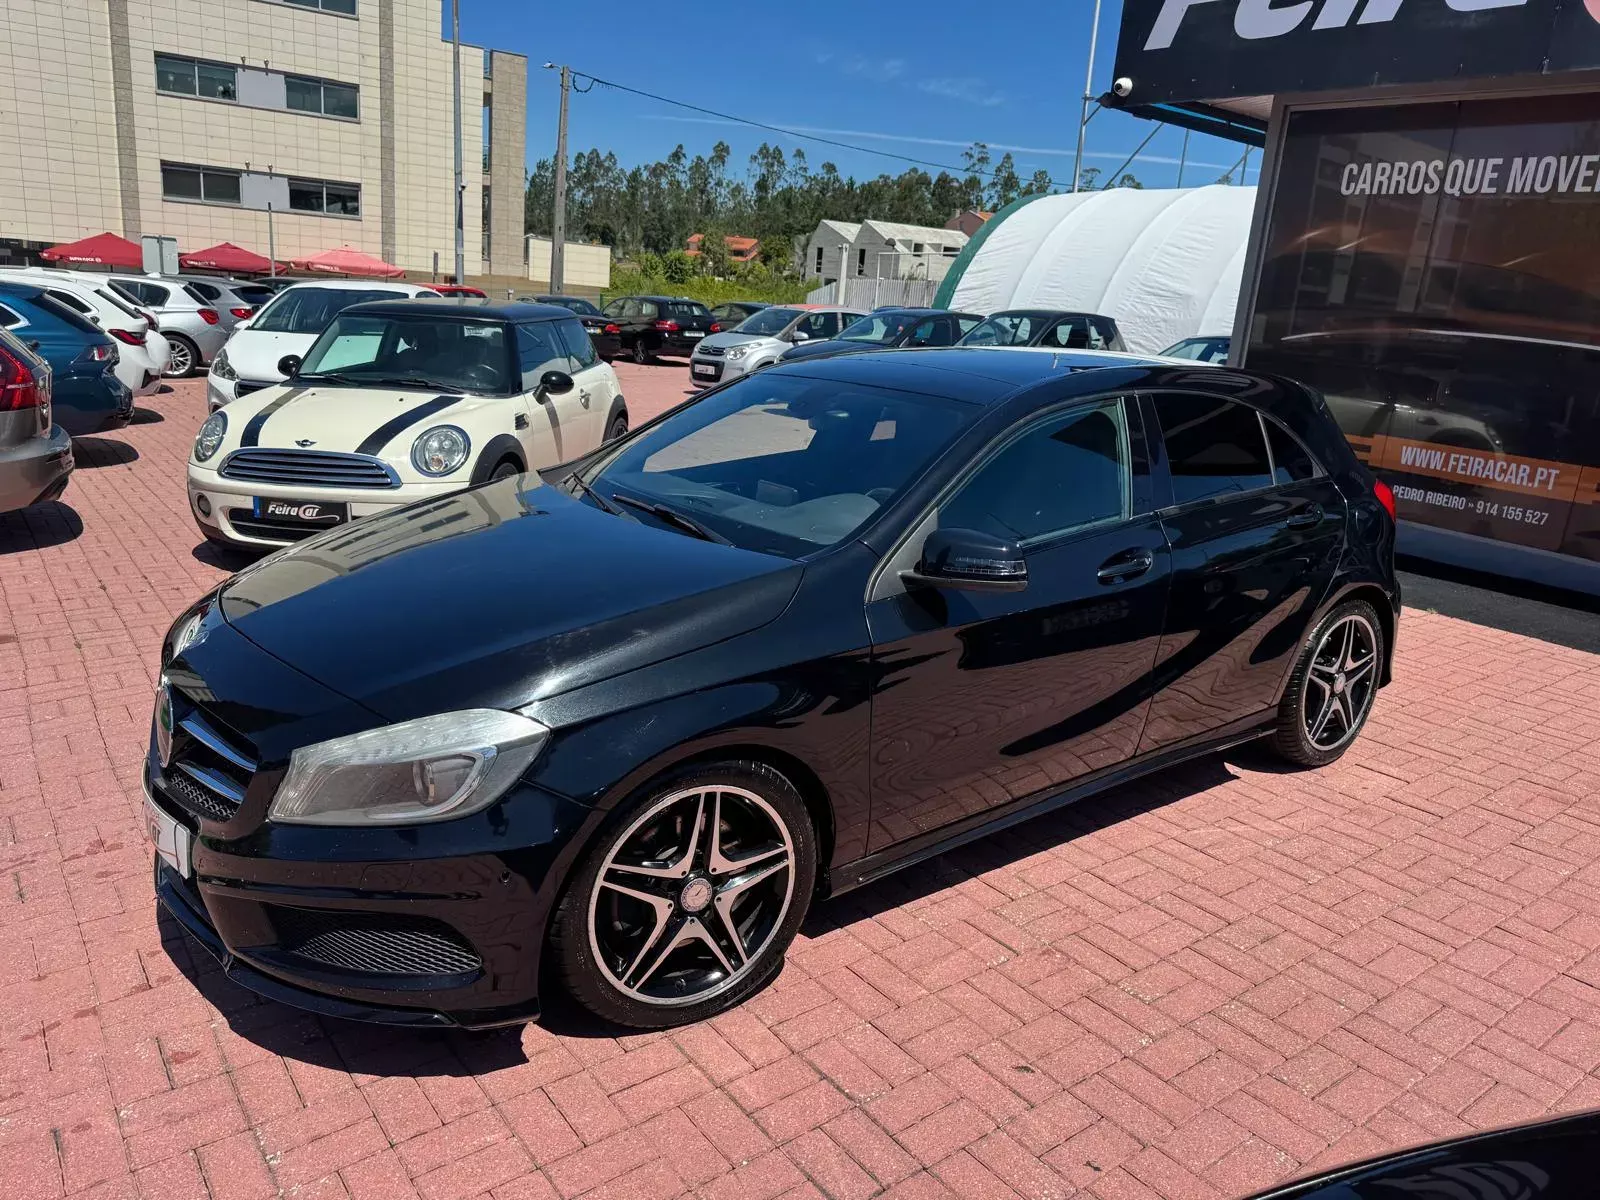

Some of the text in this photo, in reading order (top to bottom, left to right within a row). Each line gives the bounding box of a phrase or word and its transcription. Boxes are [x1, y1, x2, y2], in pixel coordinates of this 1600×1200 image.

[1340, 154, 1600, 197] CARROS QUE MOVE
[1400, 446, 1560, 490] WWW.FEIRACAR.PT
[1393, 485, 1424, 502] PEDRO
[1425, 491, 1466, 510] RIBEIRO
[1476, 500, 1499, 516] 914
[1502, 505, 1523, 521] 155
[1524, 509, 1549, 526] 527
